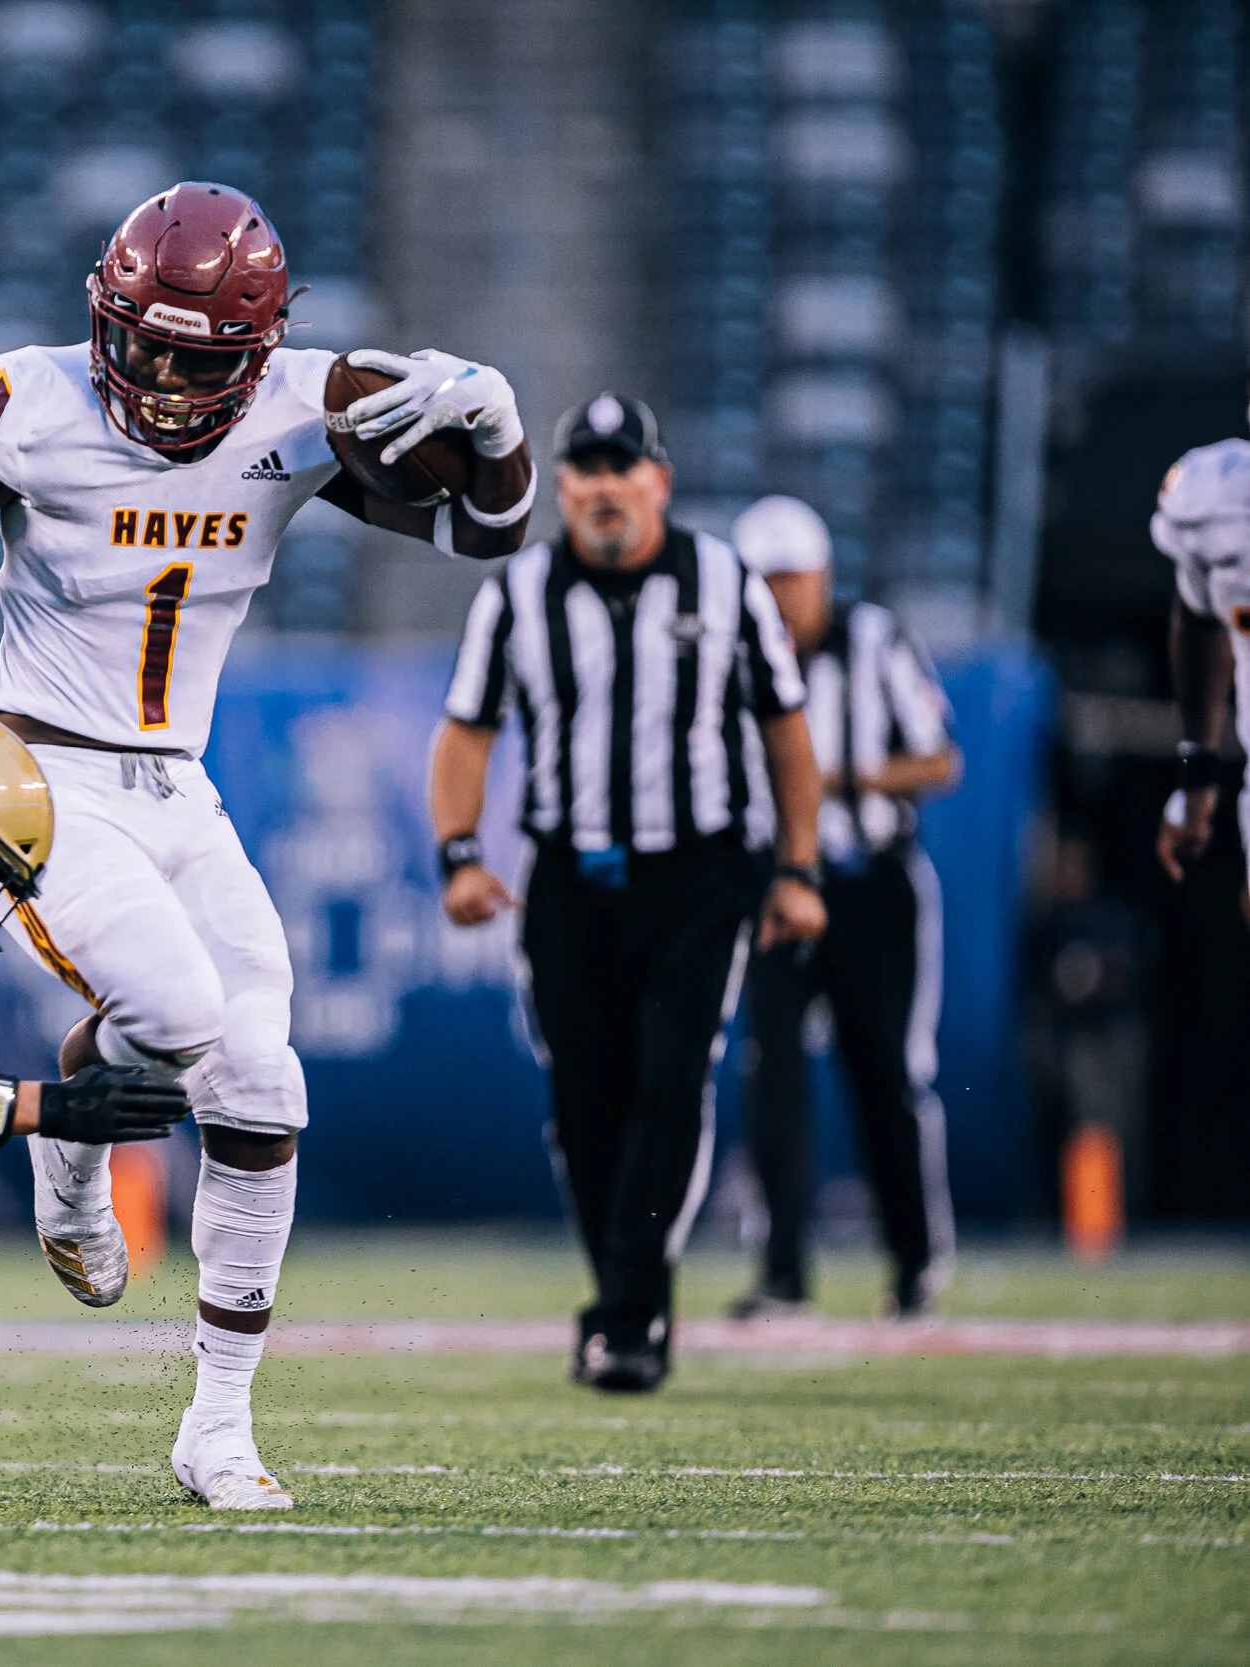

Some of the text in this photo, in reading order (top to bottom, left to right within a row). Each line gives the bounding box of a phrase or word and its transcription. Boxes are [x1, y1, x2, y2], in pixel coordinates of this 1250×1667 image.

[241, 468, 291, 481] adidas
[110, 508, 248, 549] HAYES
[137, 561, 193, 731] 1
[236, 1299, 270, 1309] adidas
